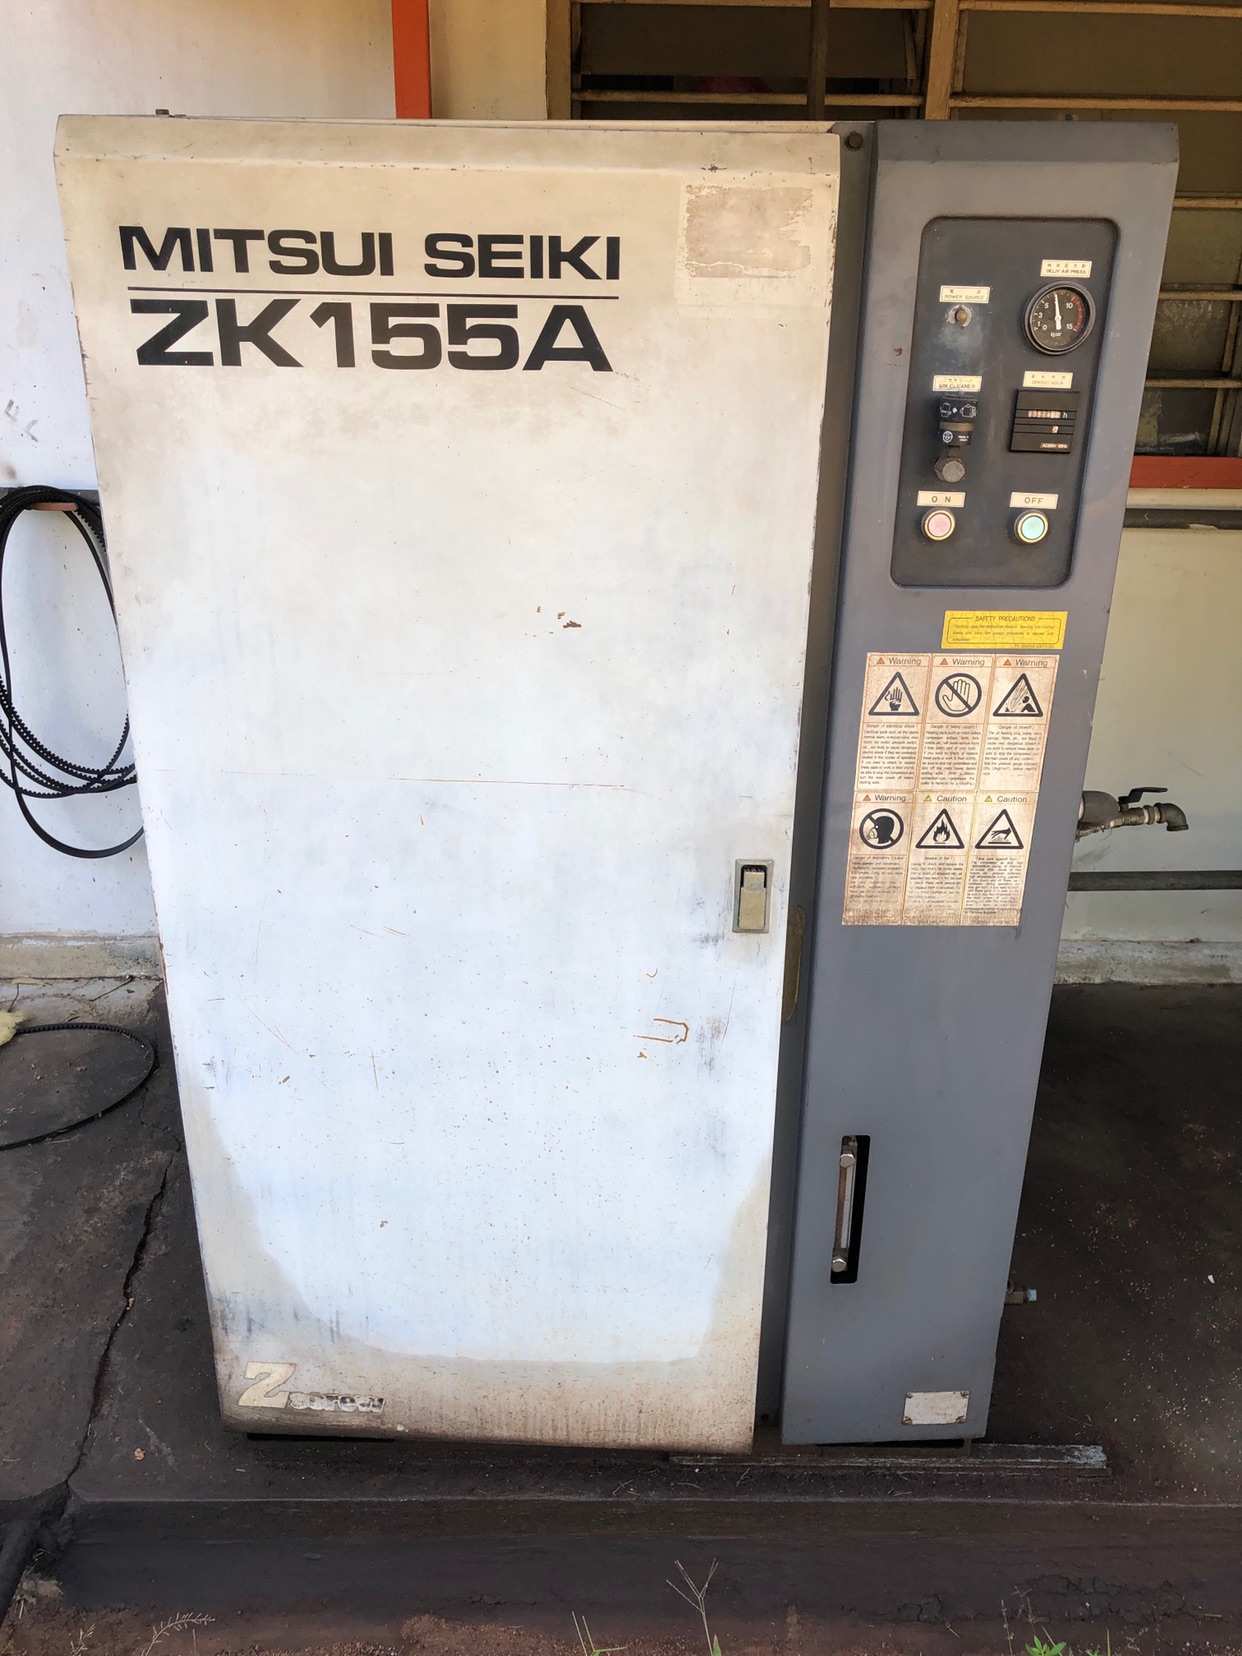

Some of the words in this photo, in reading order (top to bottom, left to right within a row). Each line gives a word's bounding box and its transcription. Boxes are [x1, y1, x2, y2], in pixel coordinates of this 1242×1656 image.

[119, 226, 394, 277] MITSUI
[424, 233, 620, 280] SEIKI
[129, 298, 614, 372] ZK155A
[888, 658, 922, 666] Warning
[952, 658, 985, 666] Warning
[1016, 659, 1048, 667] Warning
